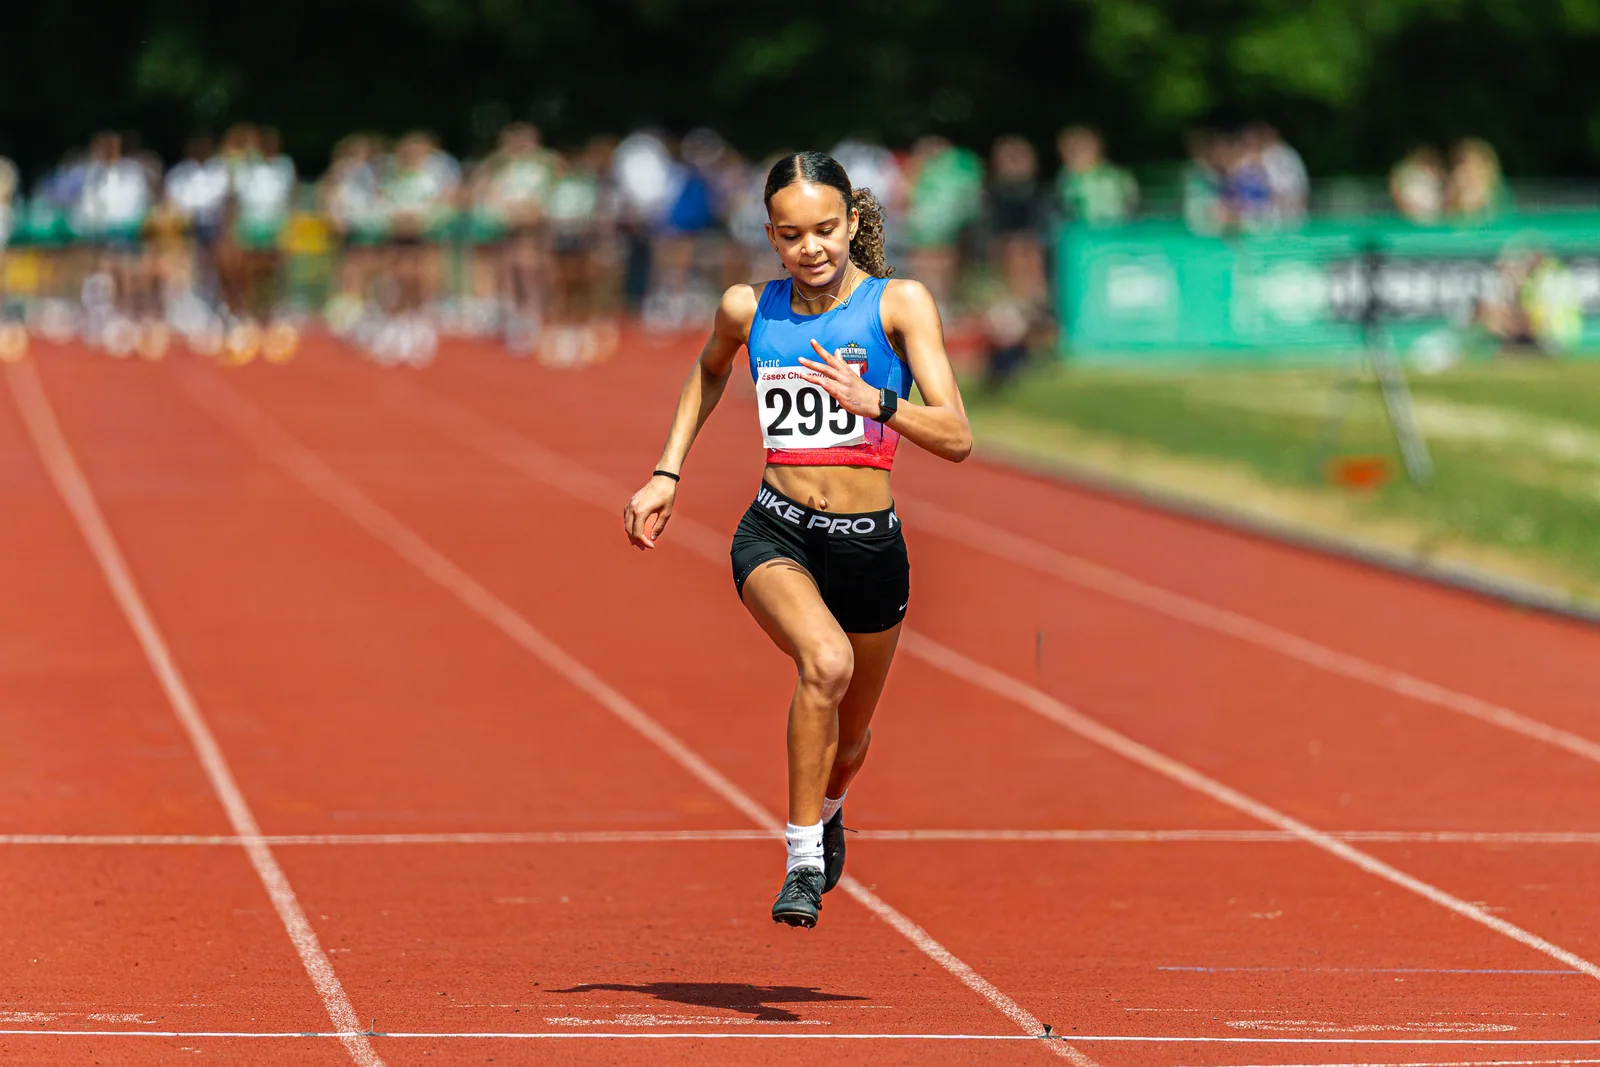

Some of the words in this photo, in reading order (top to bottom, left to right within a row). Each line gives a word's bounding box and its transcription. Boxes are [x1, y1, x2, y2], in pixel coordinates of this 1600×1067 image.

[761, 372, 786, 381] Essex
[765, 387, 856, 436] 295
[756, 488, 805, 525] NIKE
[807, 514, 876, 535] PRO
